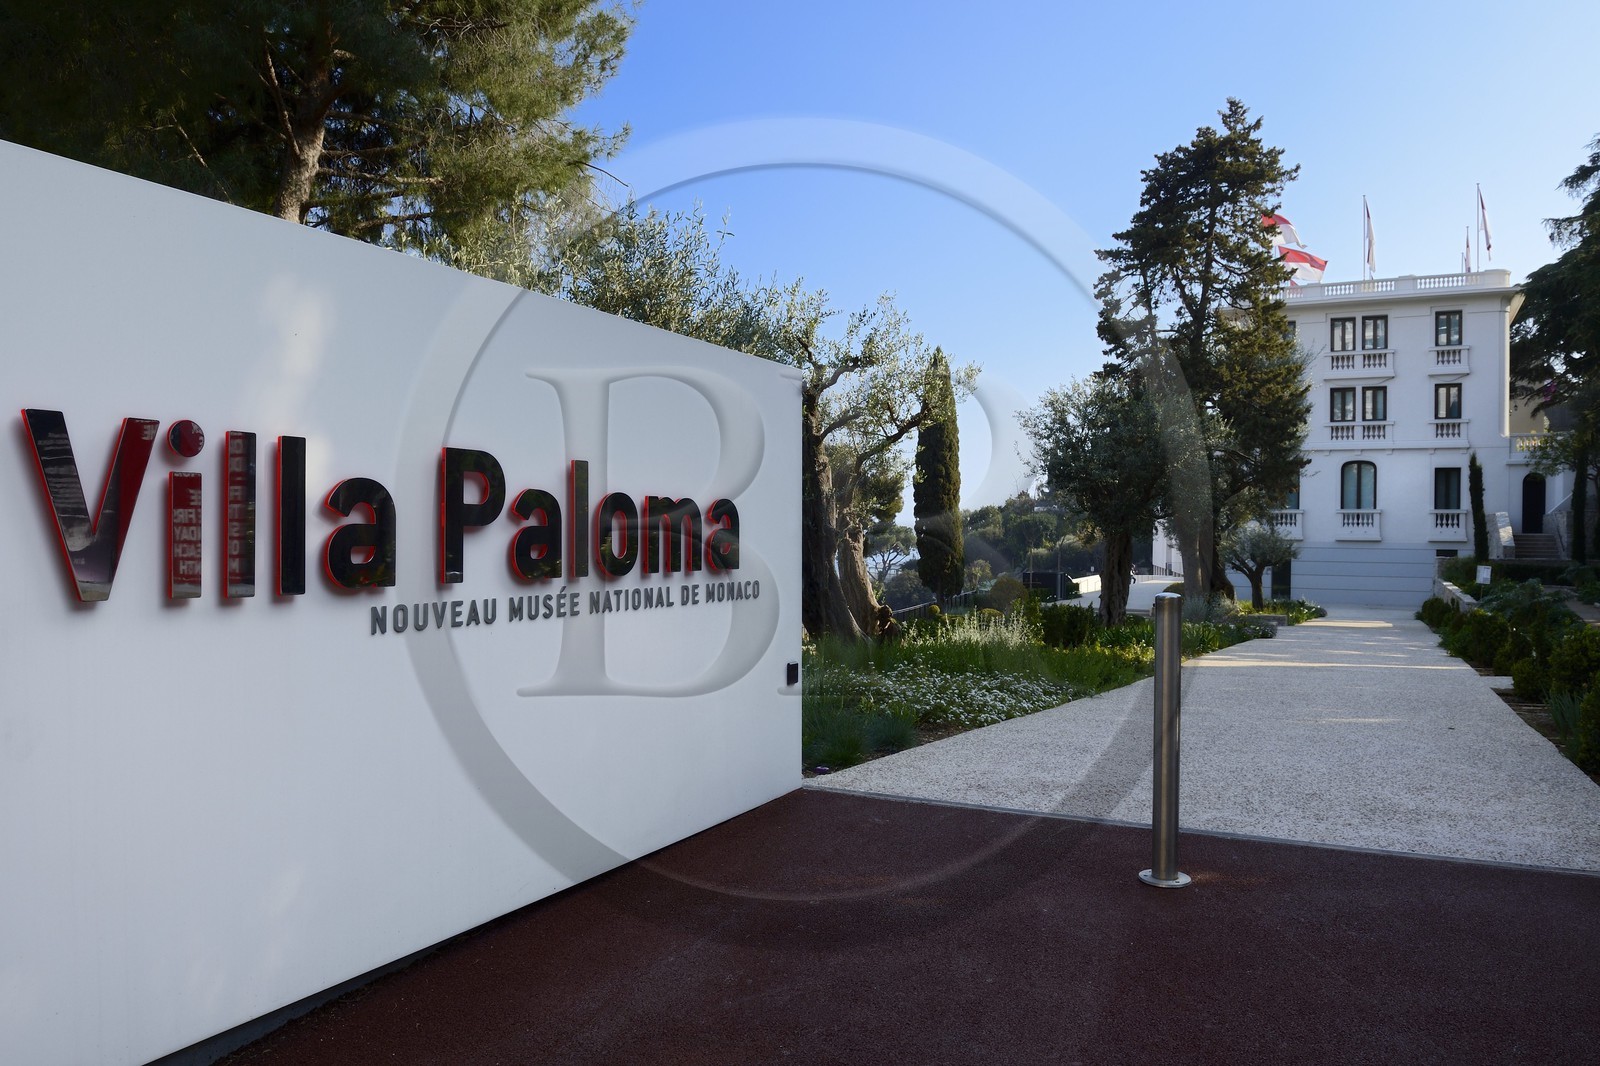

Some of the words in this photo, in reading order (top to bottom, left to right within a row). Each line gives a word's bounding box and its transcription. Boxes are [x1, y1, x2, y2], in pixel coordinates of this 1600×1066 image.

[21, 407, 397, 603] Villa
[441, 446, 740, 584] Paloma
[370, 598, 497, 636] NOUVEAU
[508, 585, 581, 623] MUSÉE
[589, 586, 675, 615] NATIONAL
[681, 584, 700, 606] DE
[705, 579, 760, 604] MONACO
